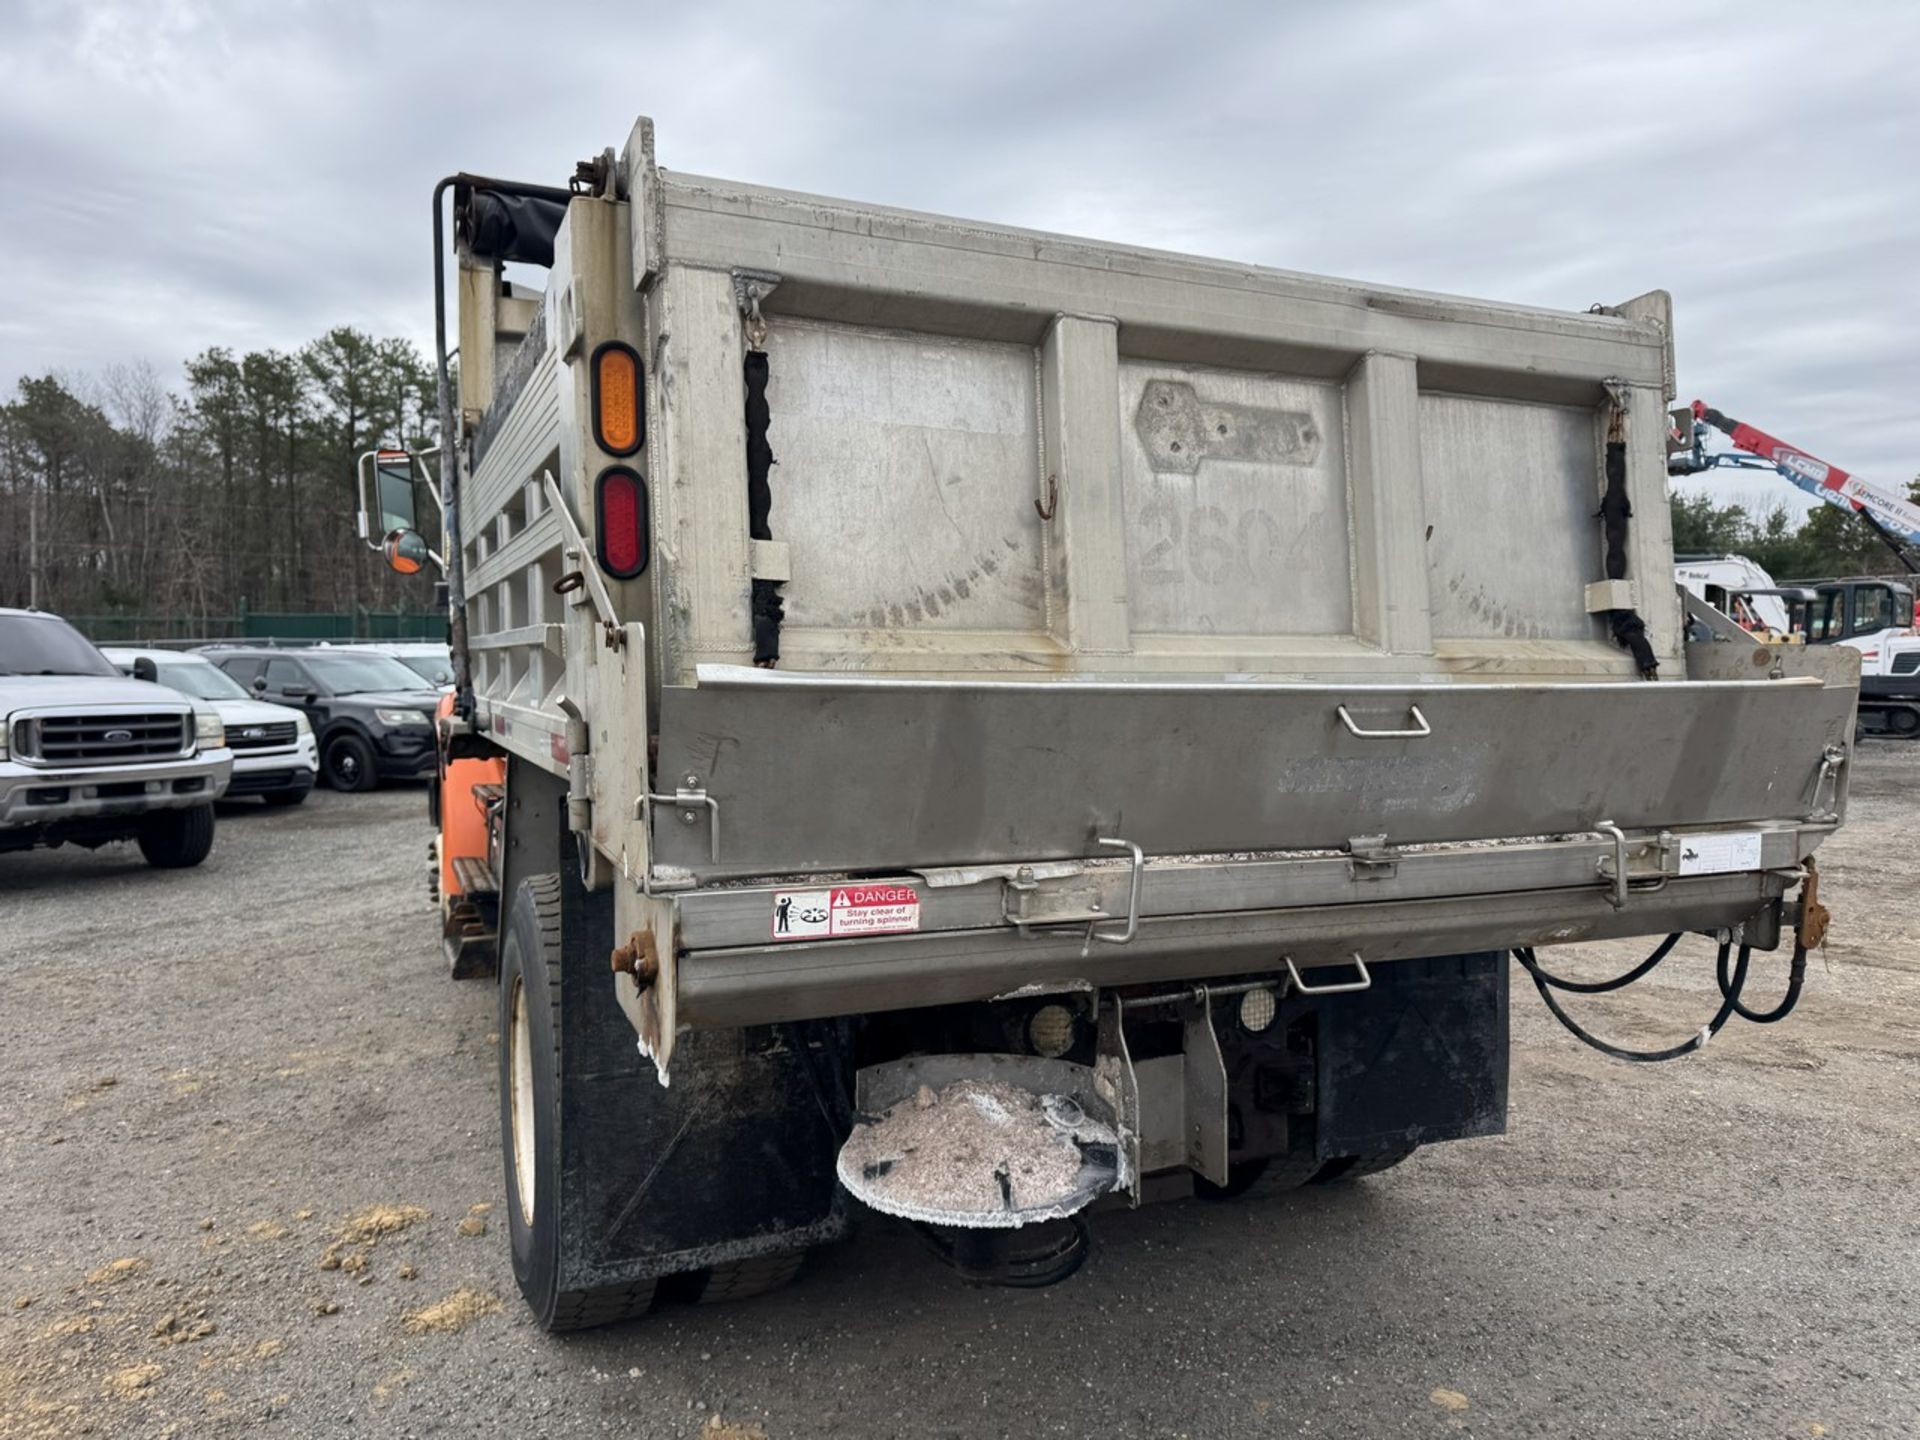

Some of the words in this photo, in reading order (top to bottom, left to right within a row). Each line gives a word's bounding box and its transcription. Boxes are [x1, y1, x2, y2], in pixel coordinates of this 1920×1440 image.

[1139, 502, 1321, 585] 2604
[854, 889, 917, 903] DANGER
[847, 909, 868, 918] Stay
[871, 907, 894, 916] clear
[896, 906, 906, 914] of
[840, 917, 874, 926] turning
[877, 915, 912, 924] spinner
